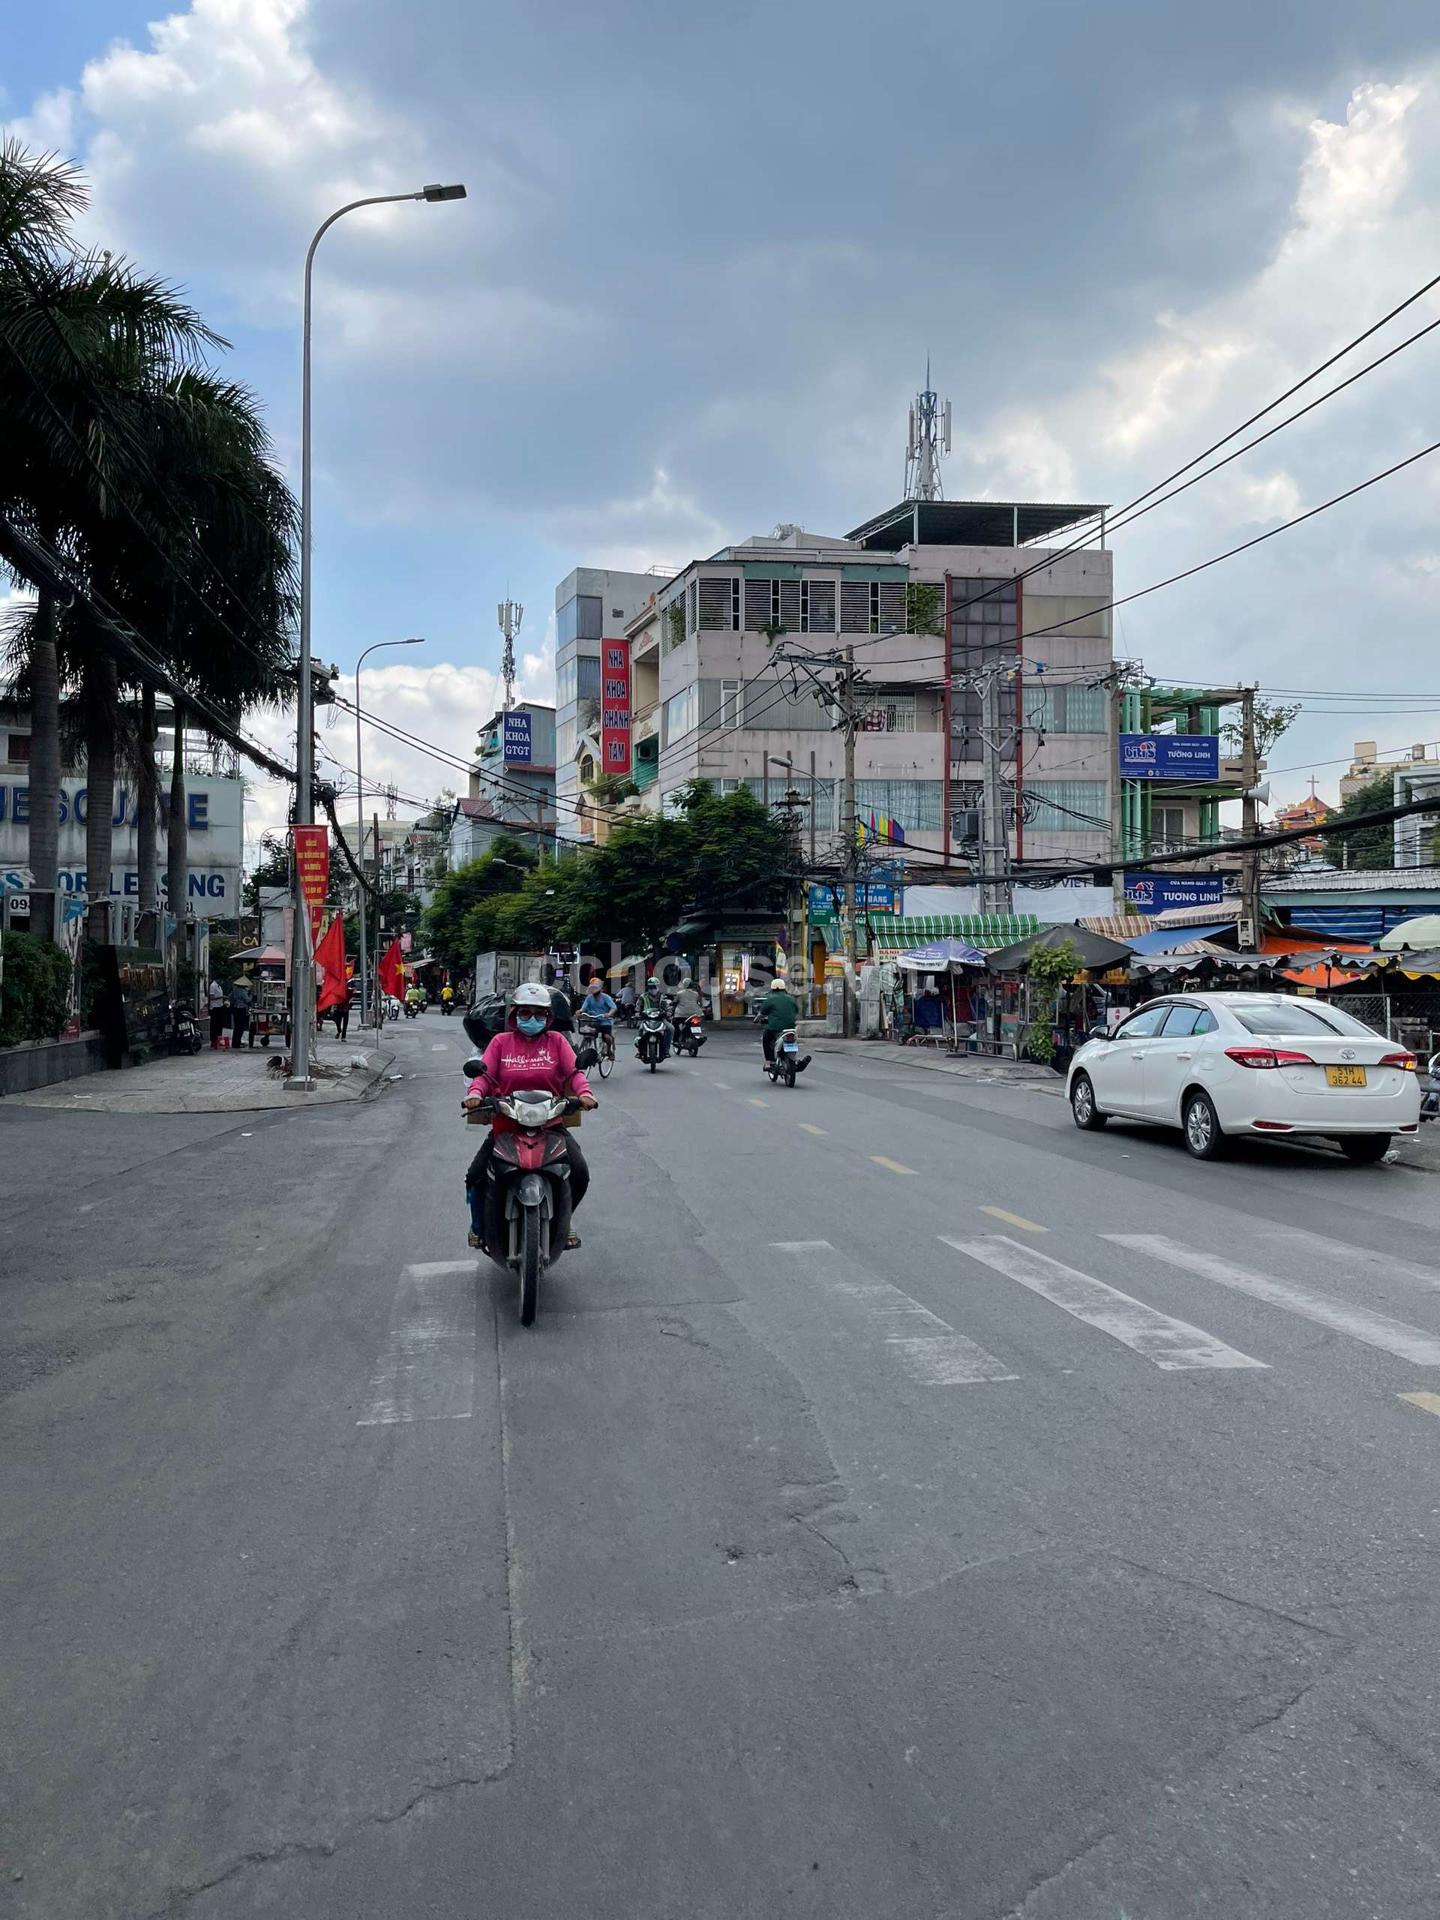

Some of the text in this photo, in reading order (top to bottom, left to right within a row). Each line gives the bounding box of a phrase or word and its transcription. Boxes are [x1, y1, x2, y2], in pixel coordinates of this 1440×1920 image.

[608, 650, 624, 668] NHA
[606, 680, 626, 698] KHOA
[508, 718, 527, 728] NHA
[505, 732, 530, 742] KHOA
[505, 745, 530, 756] GTGT
[1199, 893, 1220, 902] LINH
